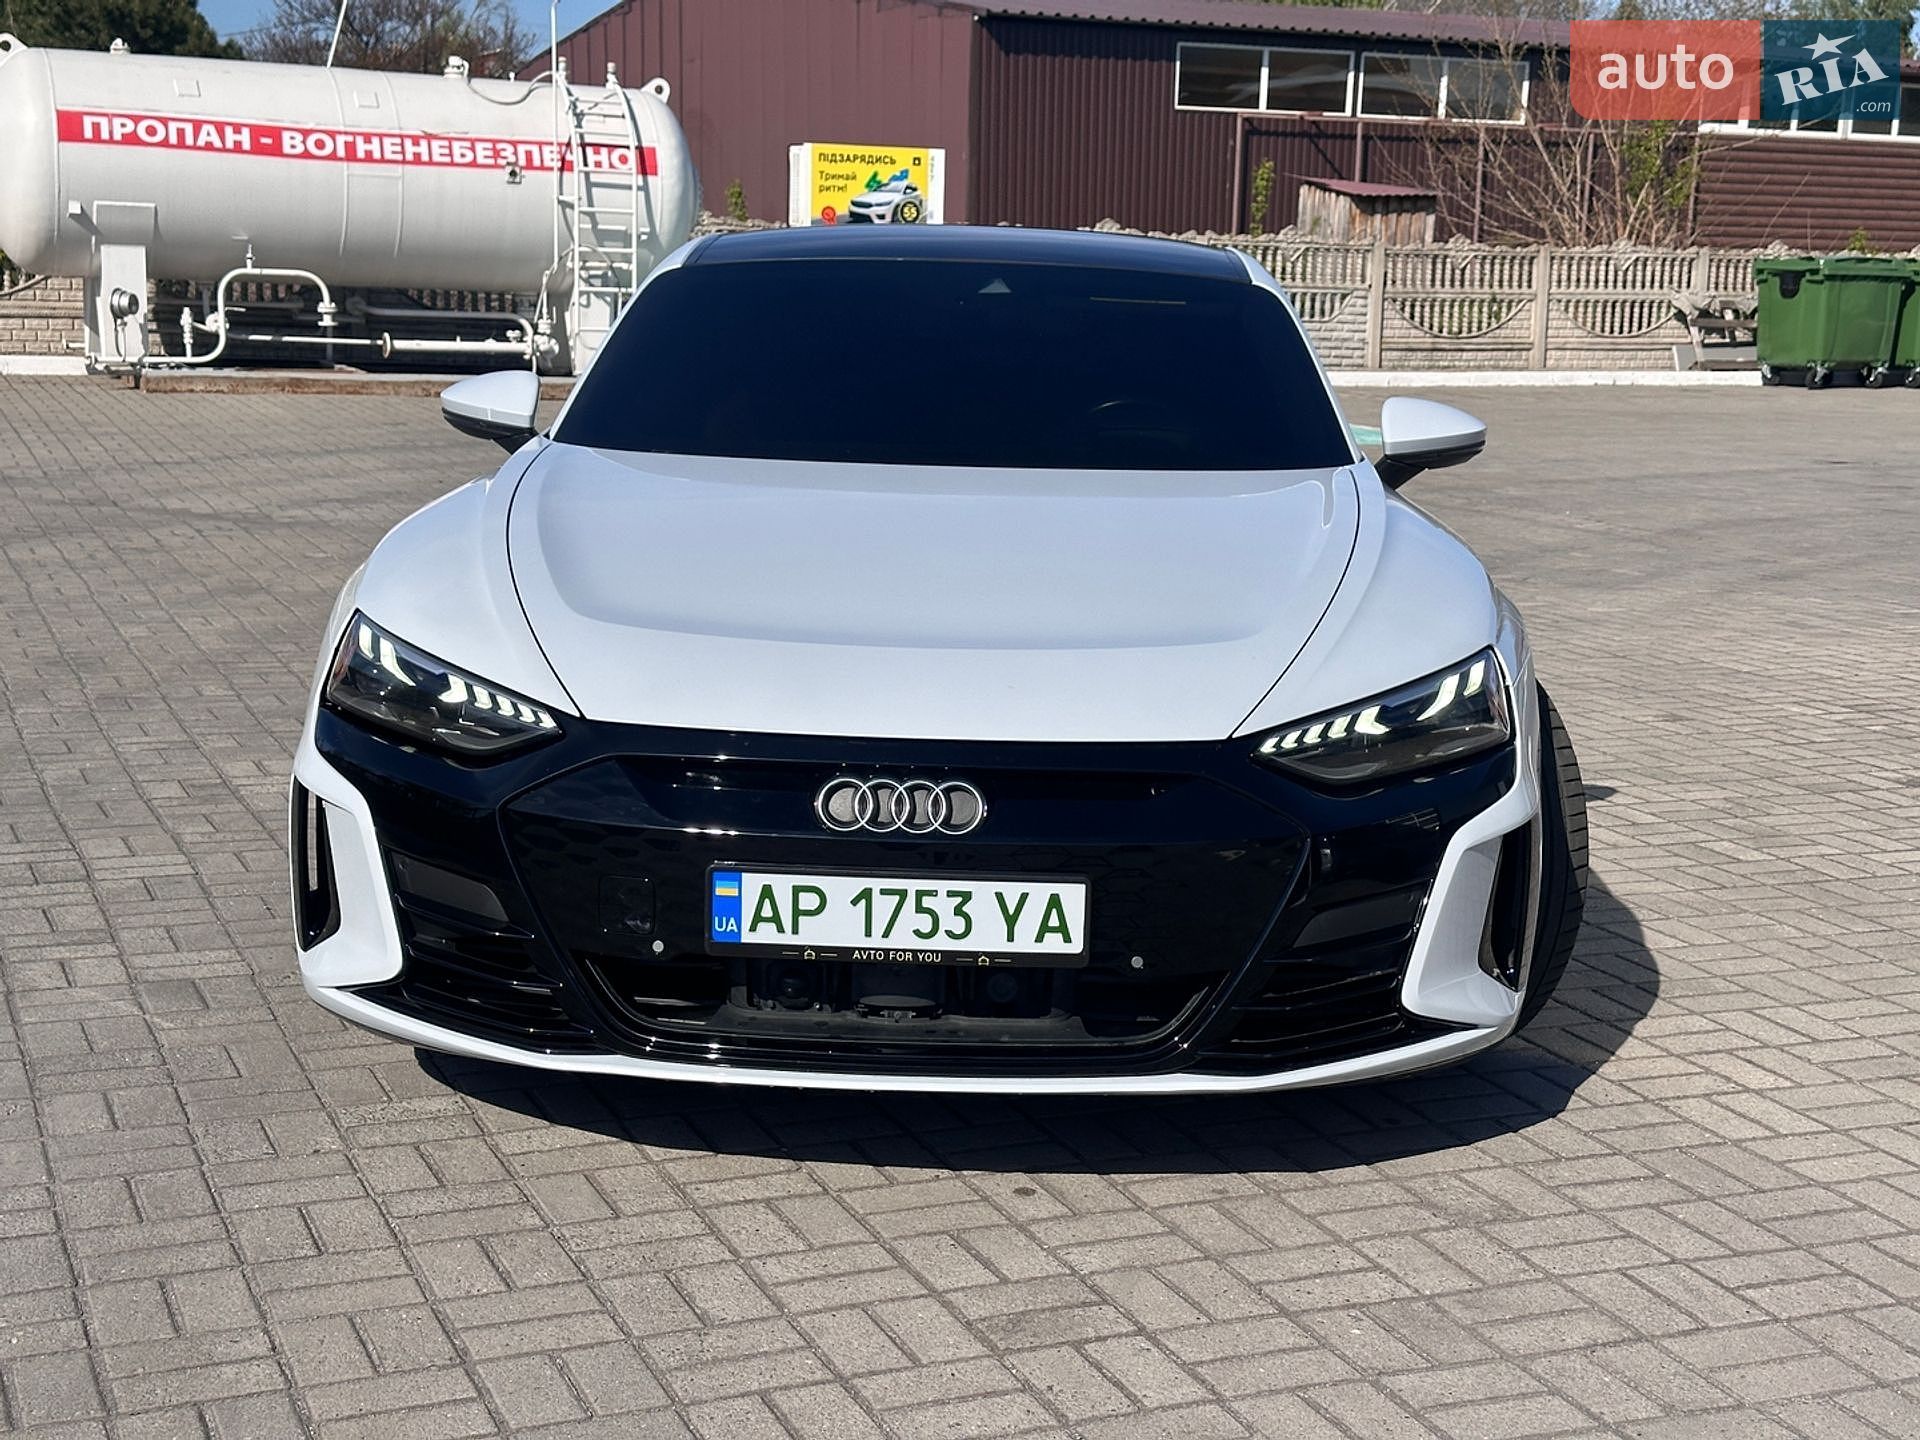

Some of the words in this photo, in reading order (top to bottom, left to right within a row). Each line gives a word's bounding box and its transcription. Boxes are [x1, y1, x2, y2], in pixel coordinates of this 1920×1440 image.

[81, 114, 252, 151] ПРОПАН
[818, 151, 897, 166] ПІДЗАРЯДИСЬ
[818, 170, 857, 182] Тримай
[748, 883, 828, 936] AP
[849, 886, 974, 941] 1753
[993, 891, 1074, 944] YA
[714, 916, 739, 933] UA
[852, 949, 884, 961] AVTO
[889, 950, 913, 962] FOR
[917, 951, 942, 963] YOU
